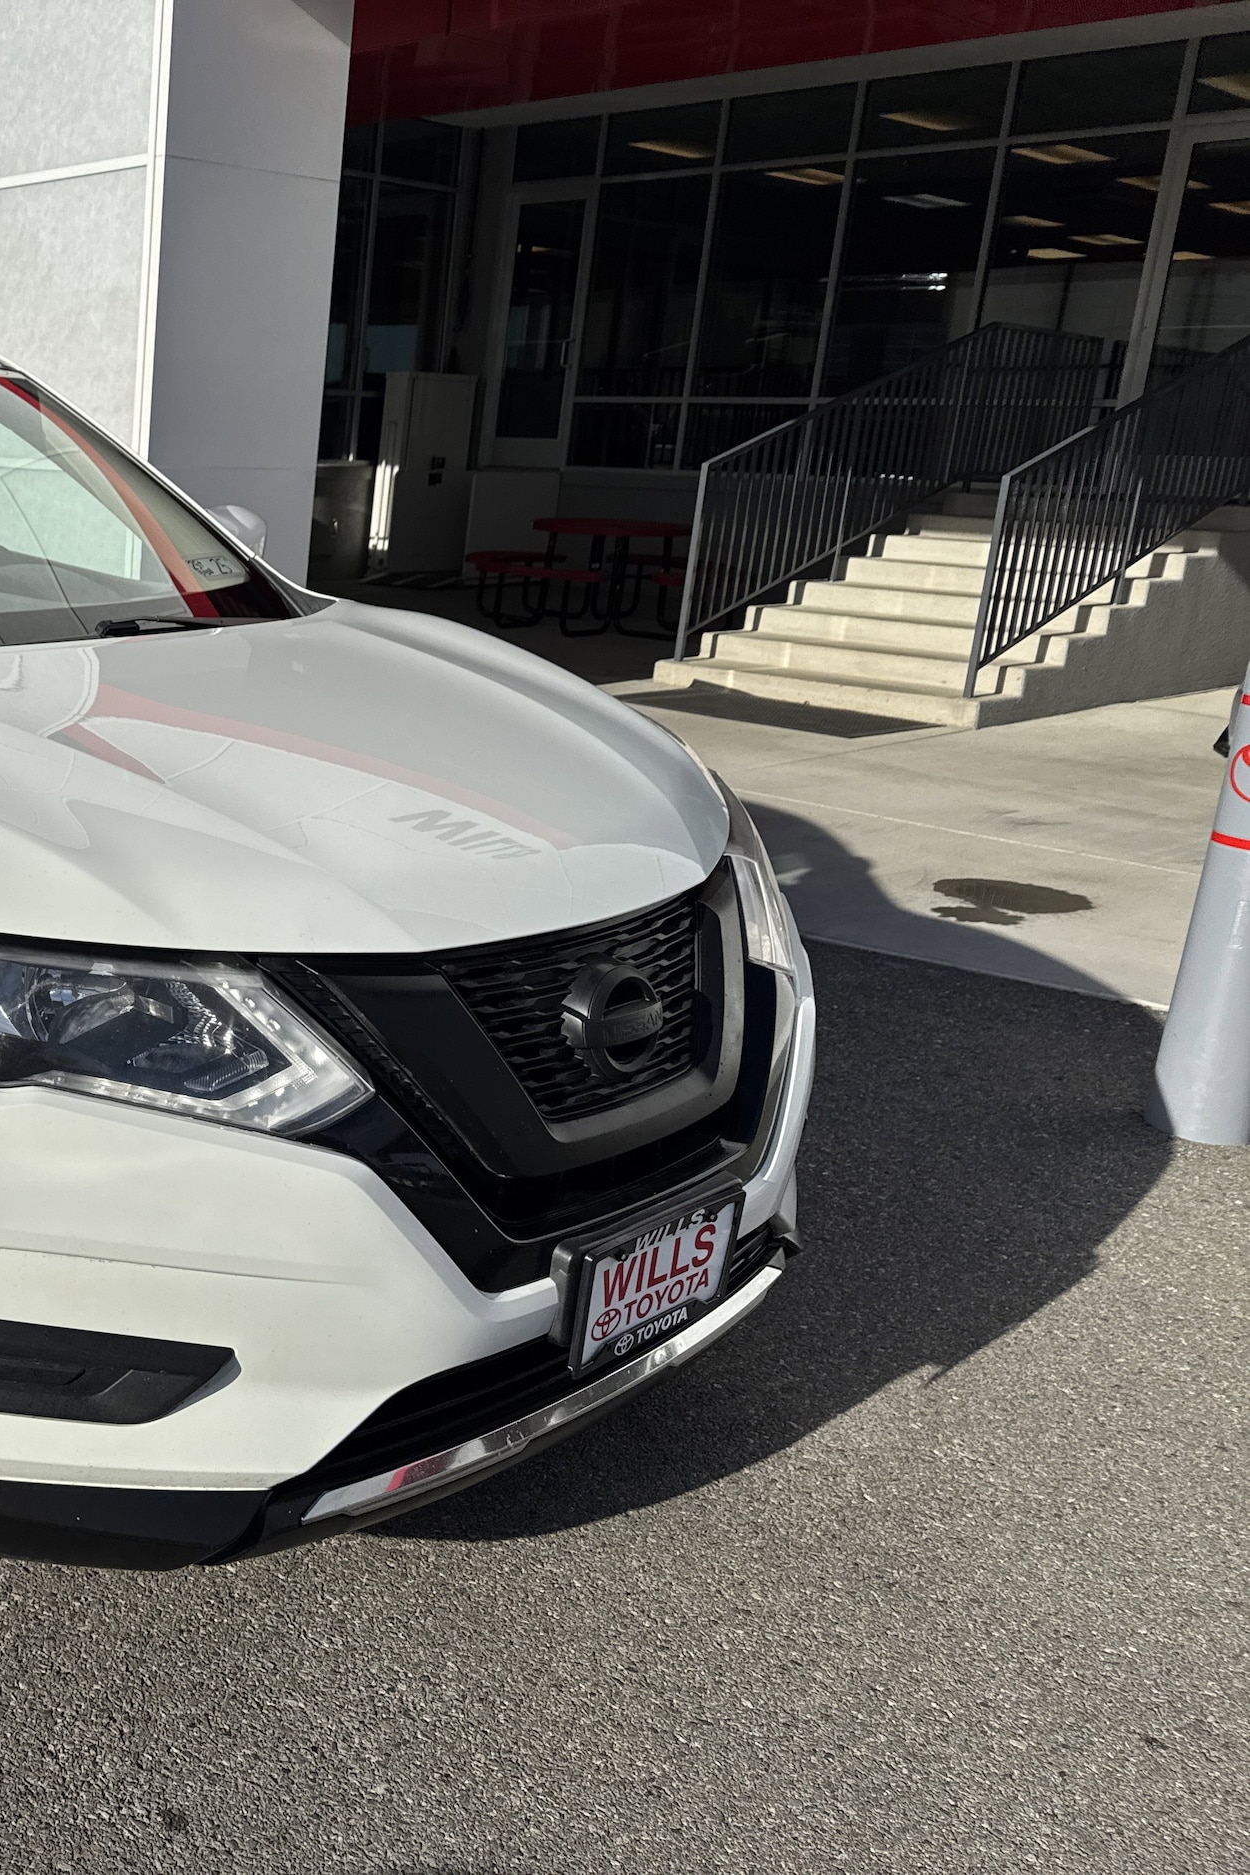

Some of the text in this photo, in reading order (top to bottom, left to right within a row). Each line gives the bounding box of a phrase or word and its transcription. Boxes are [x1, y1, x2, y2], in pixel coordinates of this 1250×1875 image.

[635, 1209, 706, 1252] WILLS
[603, 1224, 716, 1308] WILLS
[625, 1268, 709, 1325] TOYOTA
[636, 1307, 688, 1344] TOYOTA
